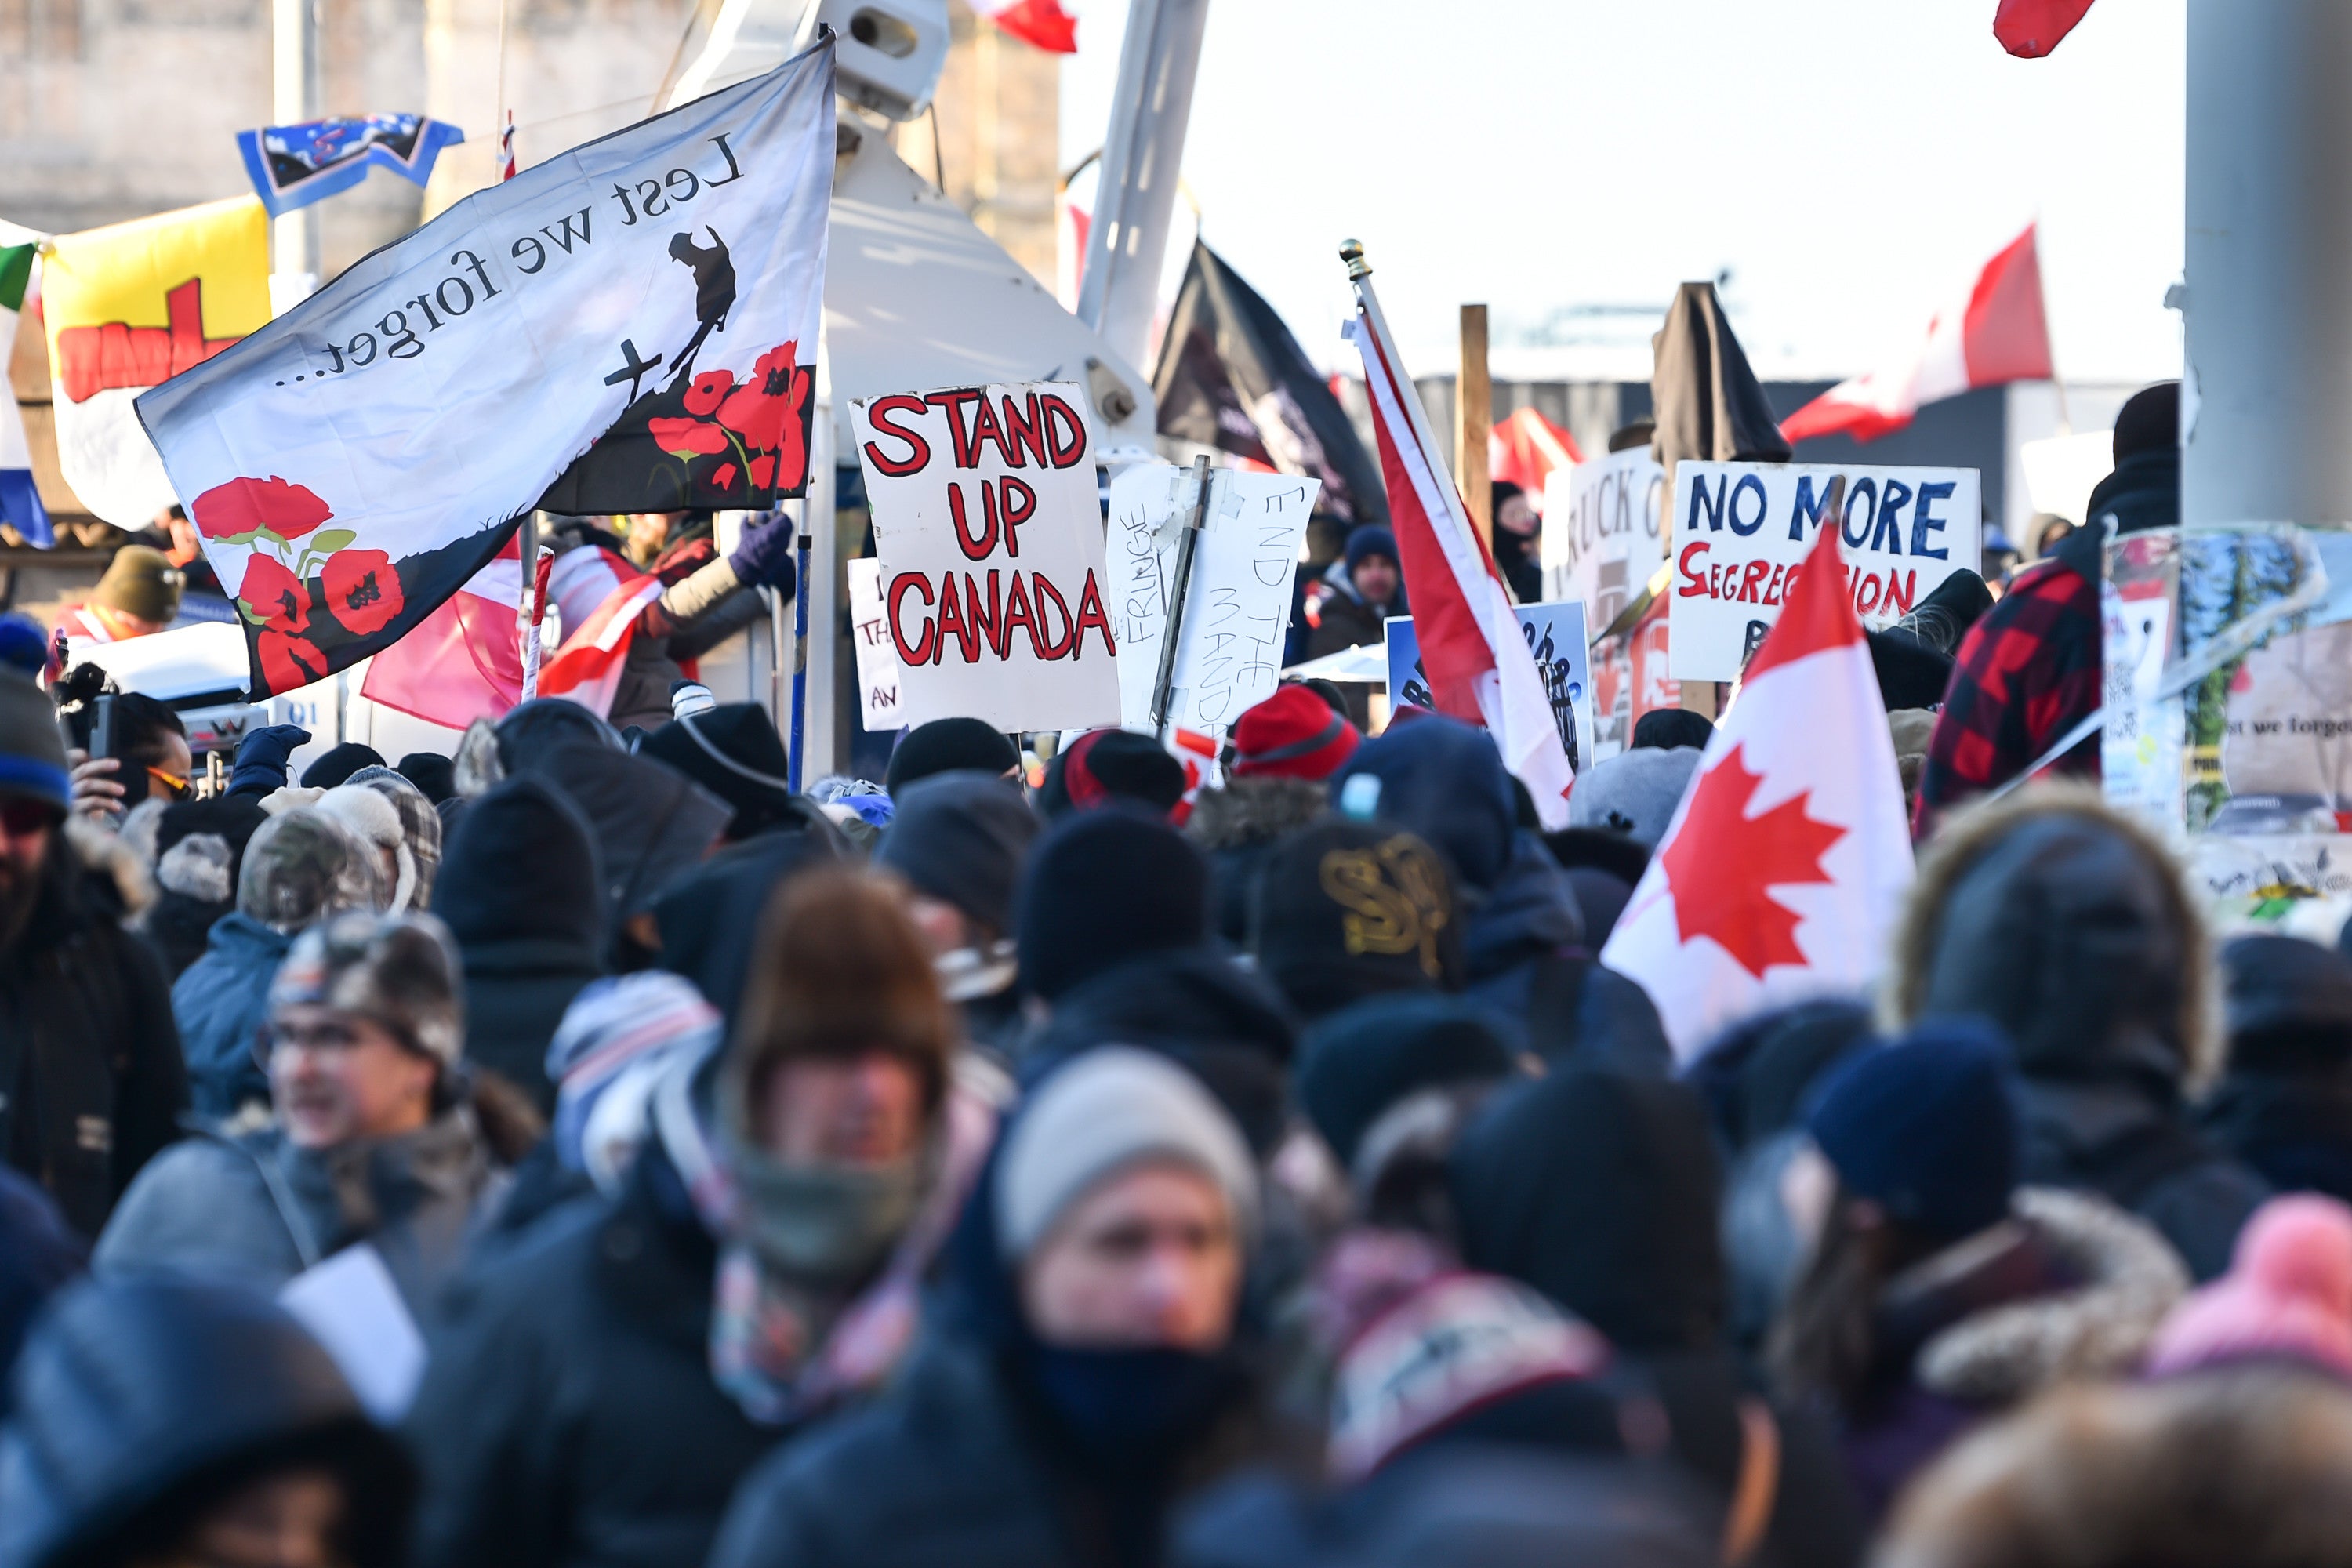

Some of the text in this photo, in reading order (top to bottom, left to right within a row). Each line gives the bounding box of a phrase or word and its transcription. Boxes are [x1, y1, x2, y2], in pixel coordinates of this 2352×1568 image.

[863, 391, 1087, 477] STAND
[948, 475, 1036, 561] UP
[1688, 474, 1957, 561] NO MORE
[887, 567, 1116, 666] CANADA
[1120, 503, 1157, 643] FRINGE
[1236, 486, 1305, 687] END THE
[856, 619, 892, 646] TH
